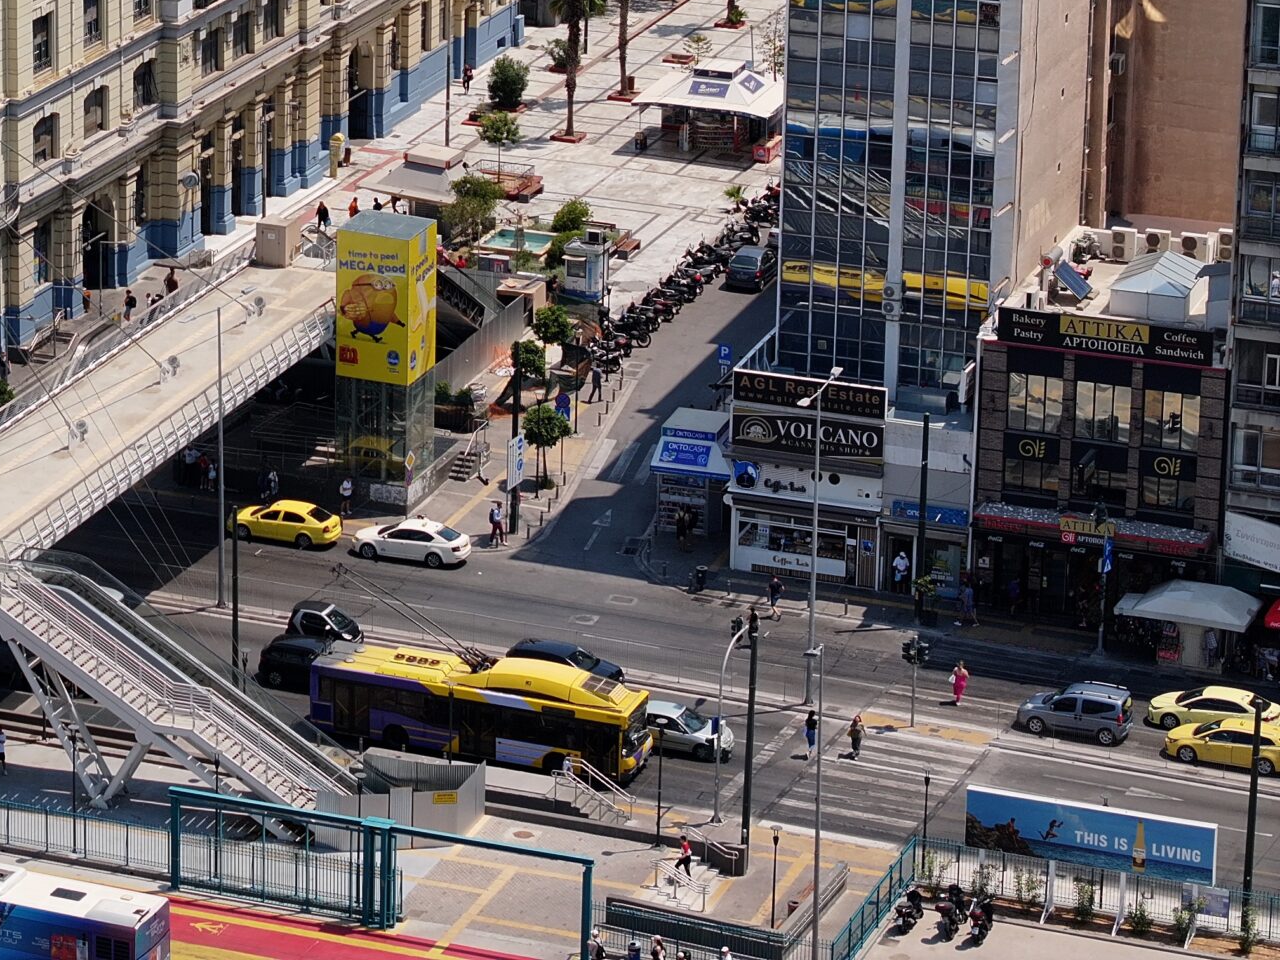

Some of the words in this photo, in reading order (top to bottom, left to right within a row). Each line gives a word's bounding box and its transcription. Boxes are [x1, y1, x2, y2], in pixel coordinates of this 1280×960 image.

[348, 250, 368, 258] time
[370, 251, 379, 259] to
[380, 253, 398, 262] peel
[339, 259, 376, 271] MEGA
[377, 264, 406, 274] good
[1012, 313, 1047, 328] Bakery
[1013, 327, 1044, 342] Pastry
[1163, 331, 1197, 345] Coffee
[721, 346, 729, 357] P
[1062, 336, 1145, 356] ΑΡΤΟΠΟΙΕΙΑ
[1155, 345, 1205, 360] Sandwich
[740, 375, 778, 391] AGL
[828, 386, 881, 405] Estate
[776, 419, 878, 448] VOLCANO
[788, 440, 835, 452] CANNBIS
[839, 446, 864, 455] SHOP
[1074, 830, 1108, 848] THIS
[1114, 836, 1128, 851] IS
[1151, 843, 1201, 863] LIVING
